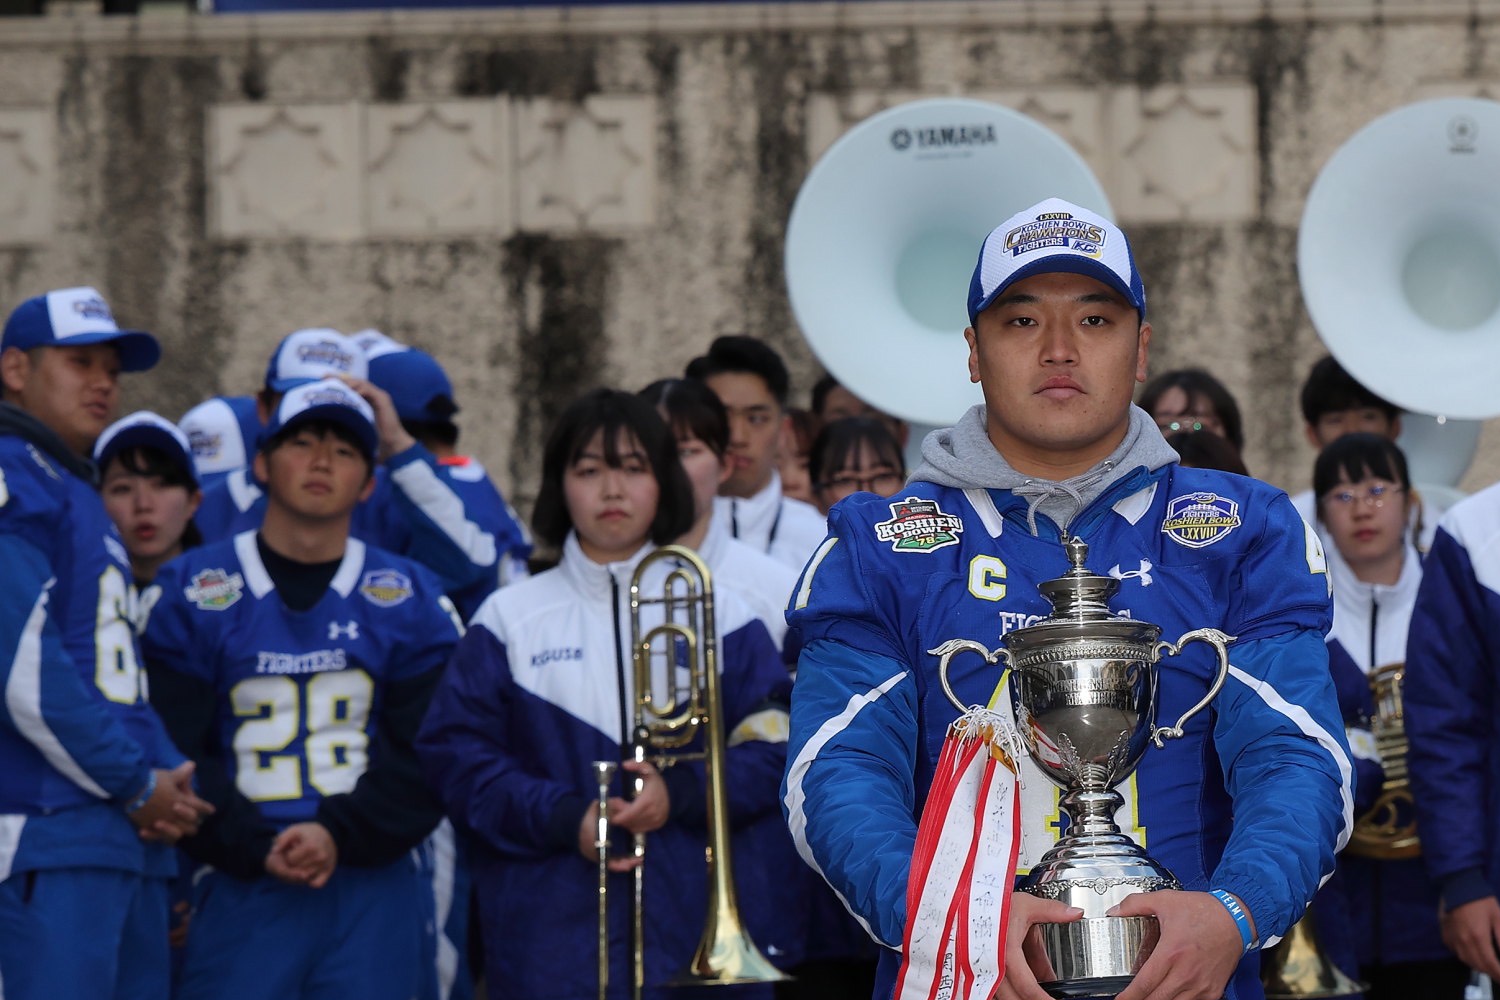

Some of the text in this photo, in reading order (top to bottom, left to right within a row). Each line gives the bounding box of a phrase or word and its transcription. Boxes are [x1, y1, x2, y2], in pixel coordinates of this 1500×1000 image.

[914, 124, 998, 148] YAMAHA
[1020, 220, 1088, 233] KOSHIEN BOWL
[1039, 213, 1070, 221] LXXVIII
[1005, 225, 1103, 250] CHAMPIONS
[1018, 237, 1065, 254] FIGHTERS
[879, 517, 960, 539] KOSHIEN
[1165, 516, 1238, 528] KOSHIEN BOWL
[902, 526, 945, 539] BOWL
[917, 536, 935, 546] 78
[1181, 527, 1218, 540] LXXVIII
[968, 554, 1007, 602] C
[256, 649, 347, 674] FIGHTERS
[229, 668, 375, 803] 28
[1220, 892, 1242, 916] TEAM
